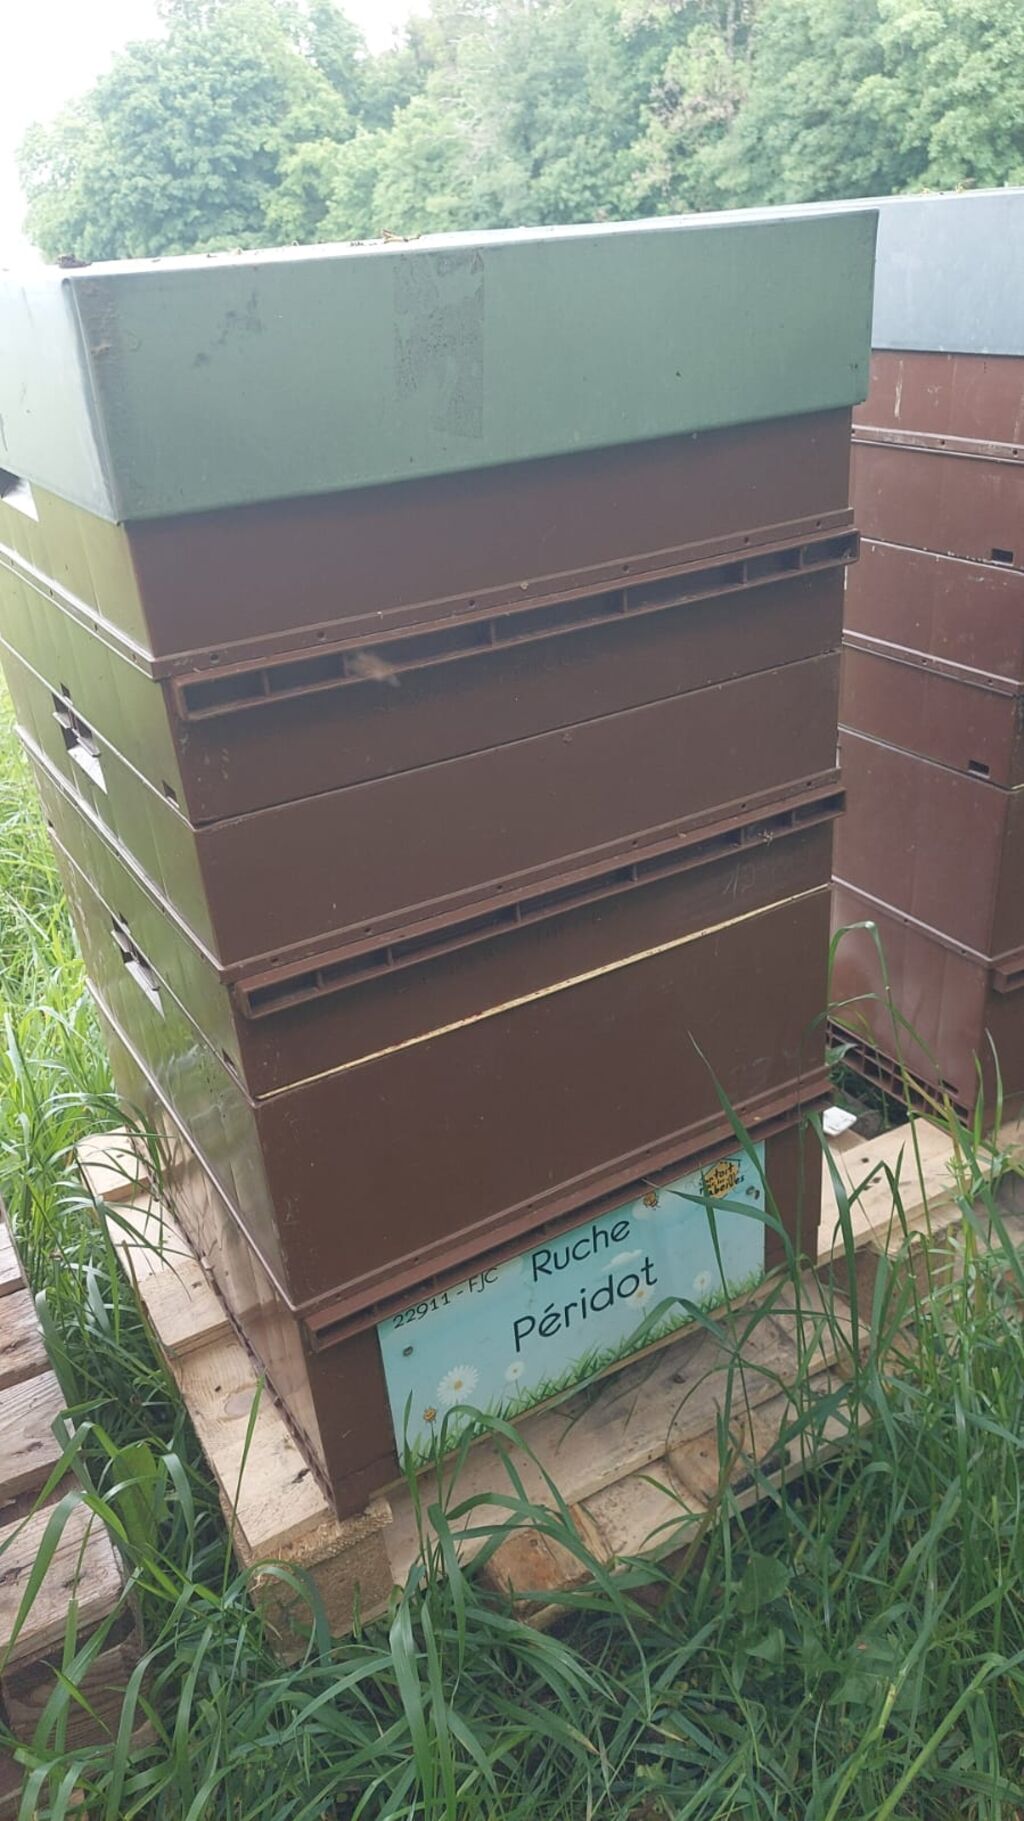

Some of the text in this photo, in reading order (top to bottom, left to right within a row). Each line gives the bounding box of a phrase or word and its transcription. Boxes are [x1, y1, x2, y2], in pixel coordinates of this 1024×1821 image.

[531, 1220, 630, 1283] Ruche
[392, 1292, 451, 1329] 22911
[468, 1267, 499, 1293] FJC
[513, 1256, 658, 1353] Péridot
